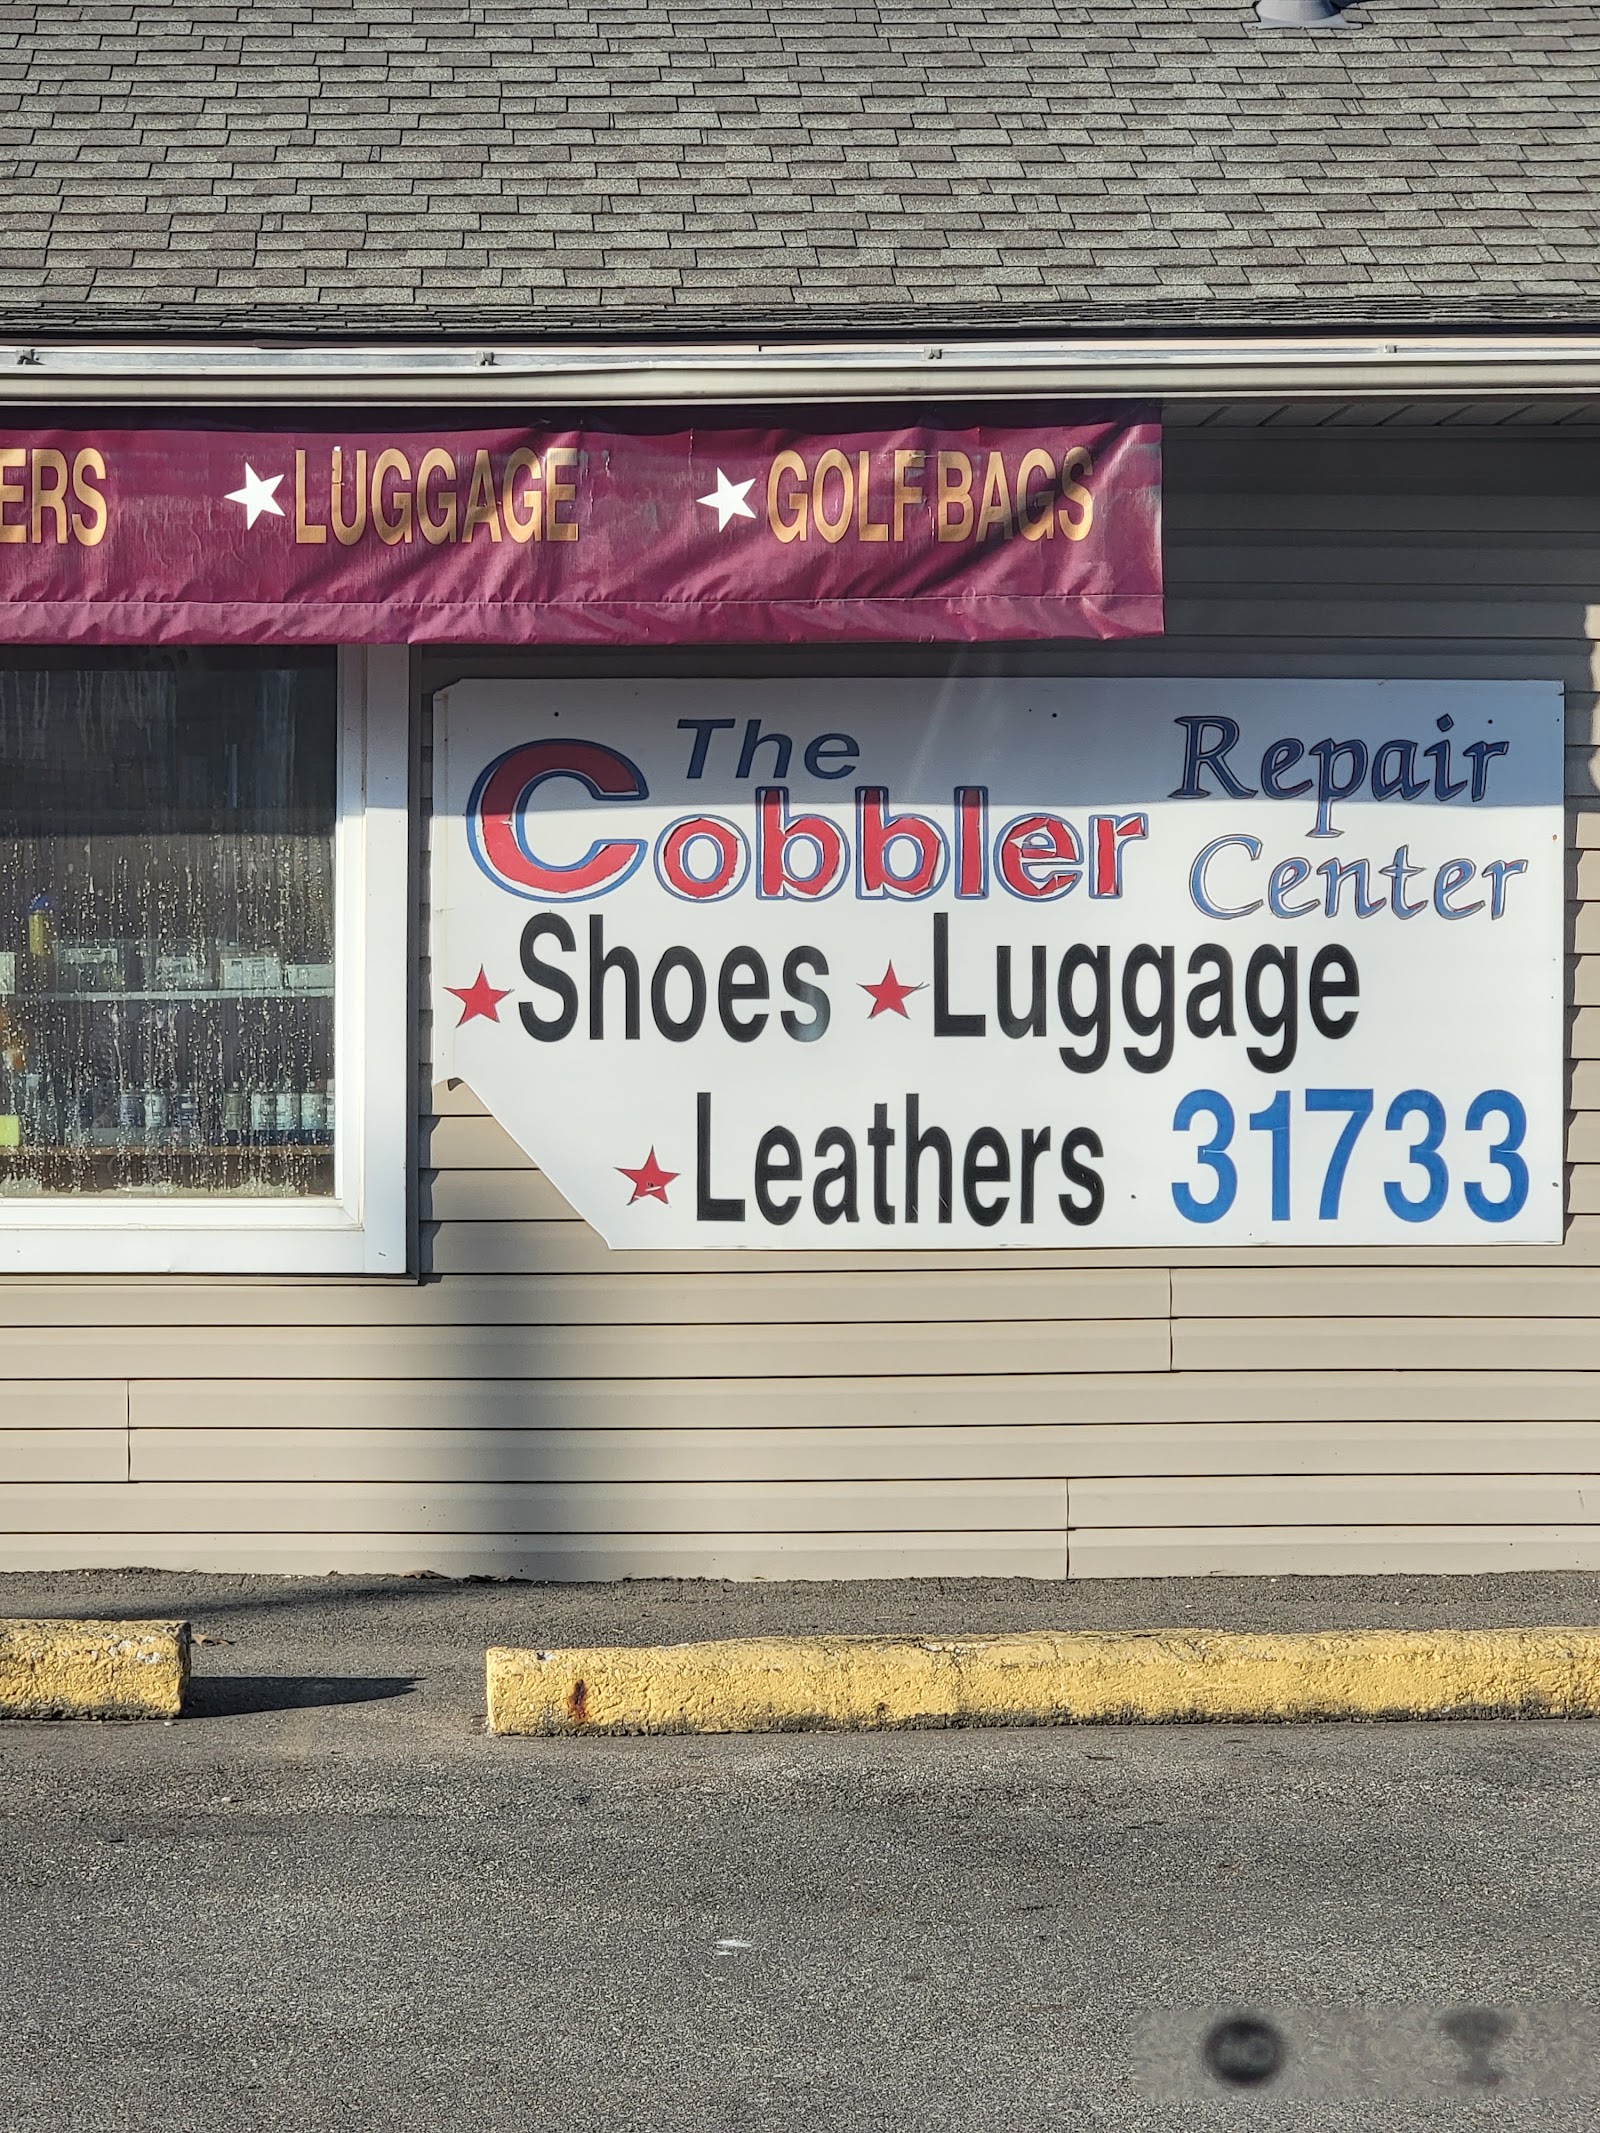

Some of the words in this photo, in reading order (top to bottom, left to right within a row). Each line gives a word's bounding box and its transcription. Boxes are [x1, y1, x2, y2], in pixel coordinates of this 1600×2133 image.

[0, 447, 108, 547] ERS
[295, 447, 579, 546] LUGGAGE
[767, 448, 926, 544] GOLF
[937, 446, 1094, 543] BAGS
[676, 718, 861, 780] The
[1167, 713, 1510, 839] Repair
[465, 738, 1150, 903] Cobbler
[1188, 833, 1529, 921] Center
[517, 912, 832, 1044] Shoes
[932, 912, 1361, 1075] Luggage
[696, 1091, 1105, 1228] Leathers
[1170, 1088, 1530, 1225] 31733
